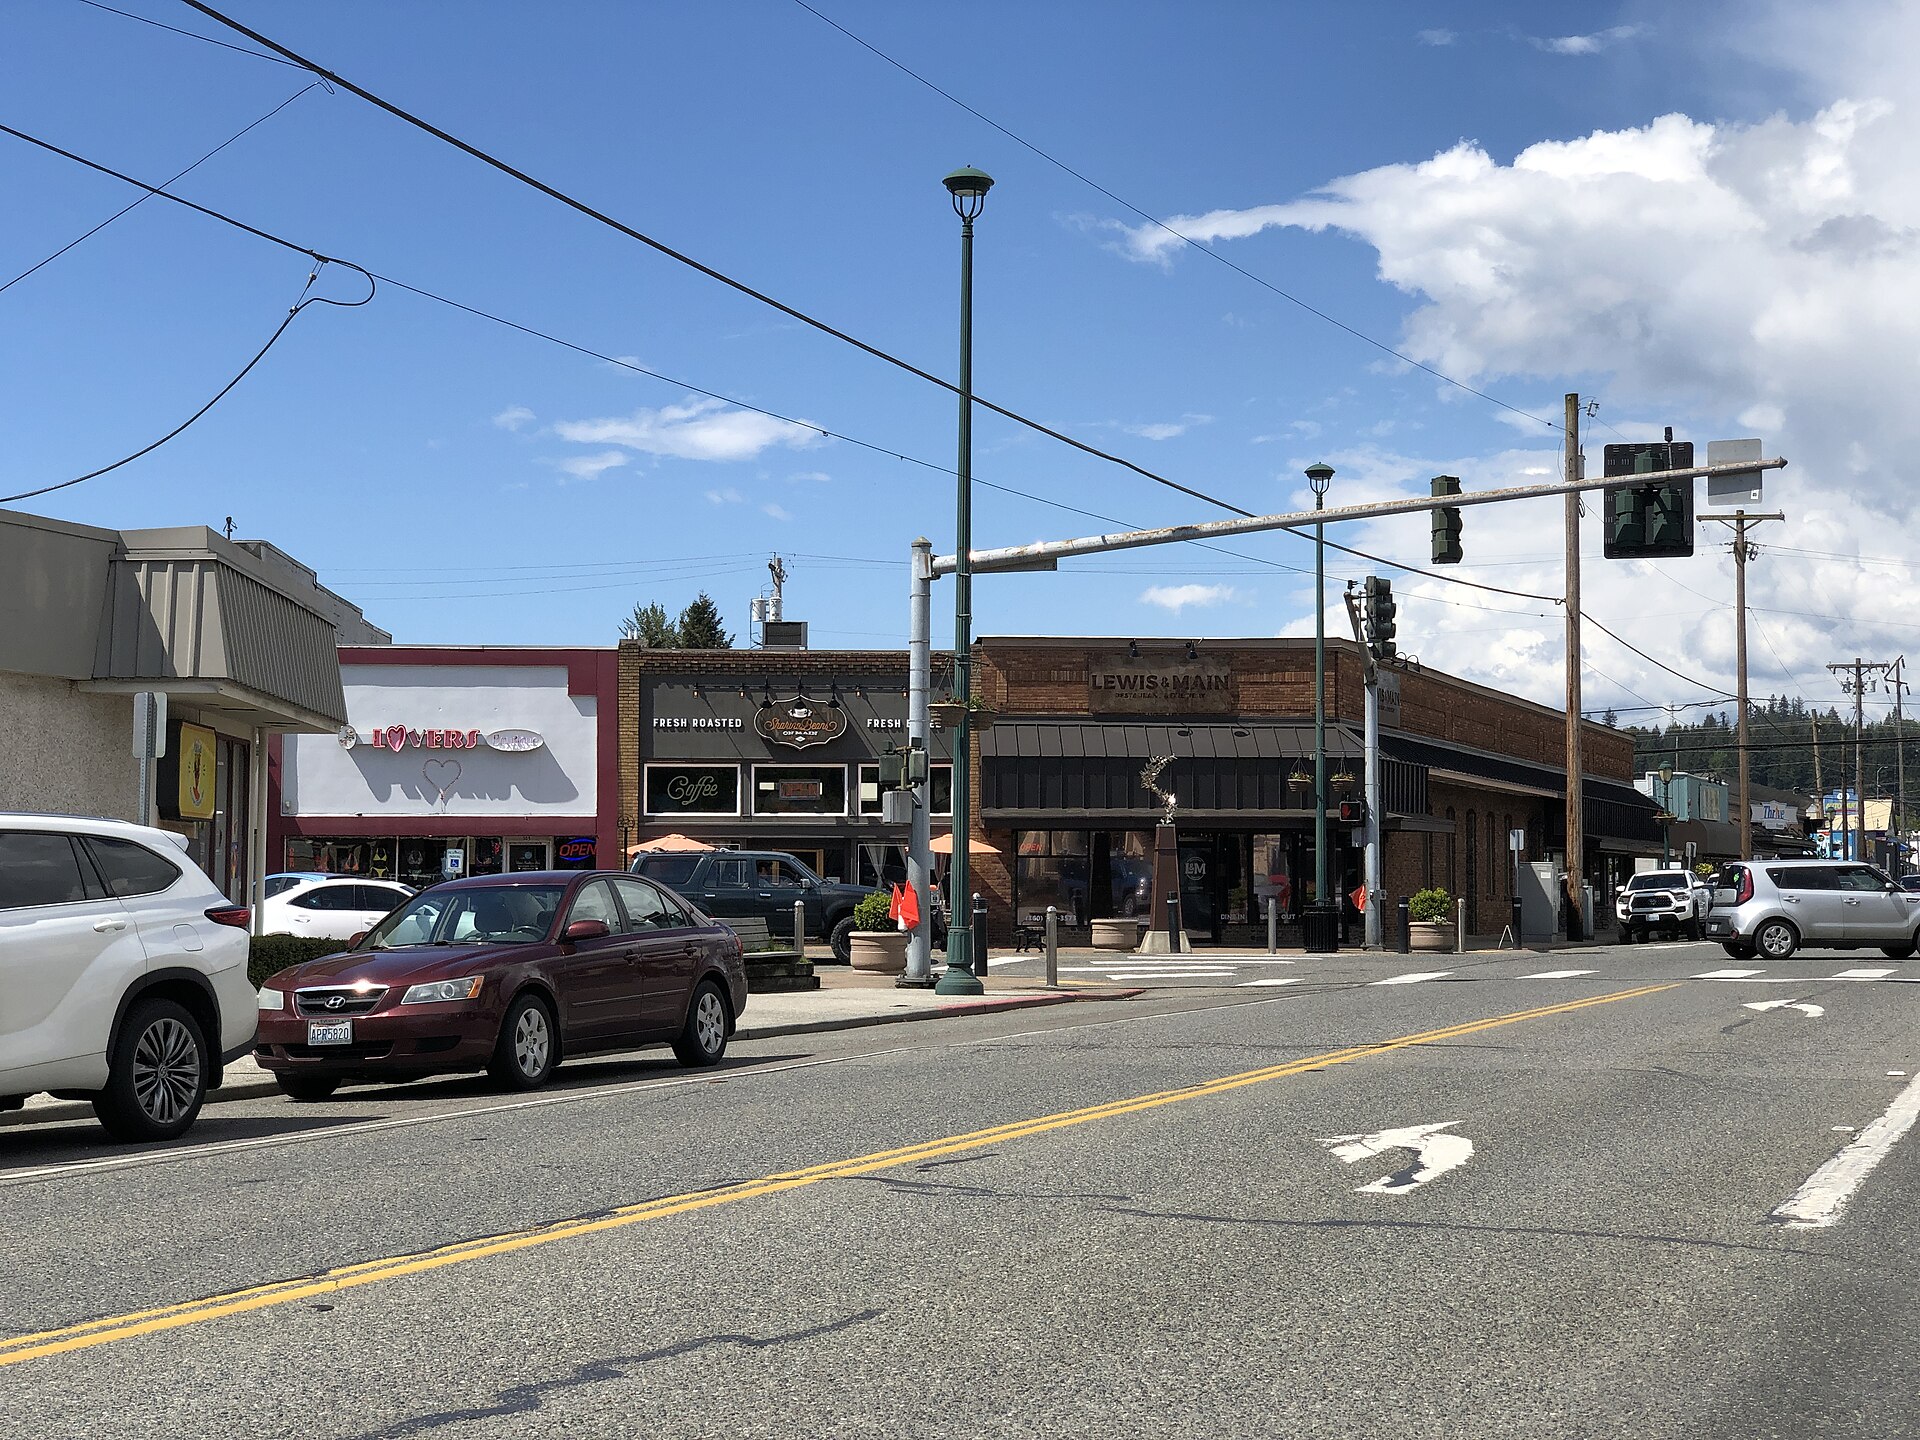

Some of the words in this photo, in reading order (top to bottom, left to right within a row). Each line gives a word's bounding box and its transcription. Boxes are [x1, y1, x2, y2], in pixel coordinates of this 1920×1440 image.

[1091, 674, 1158, 690] LEWIS
[1161, 676, 1170, 689] &
[1172, 674, 1229, 690] MAIN
[653, 718, 687, 728] FRESH
[692, 718, 742, 728] ROASTED
[867, 718, 901, 728] FRESH
[667, 775, 719, 806] Coffee
[559, 843, 596, 857] OPEN
[1020, 843, 1042, 851] OPEN
[312, 1027, 349, 1040] APR5820
